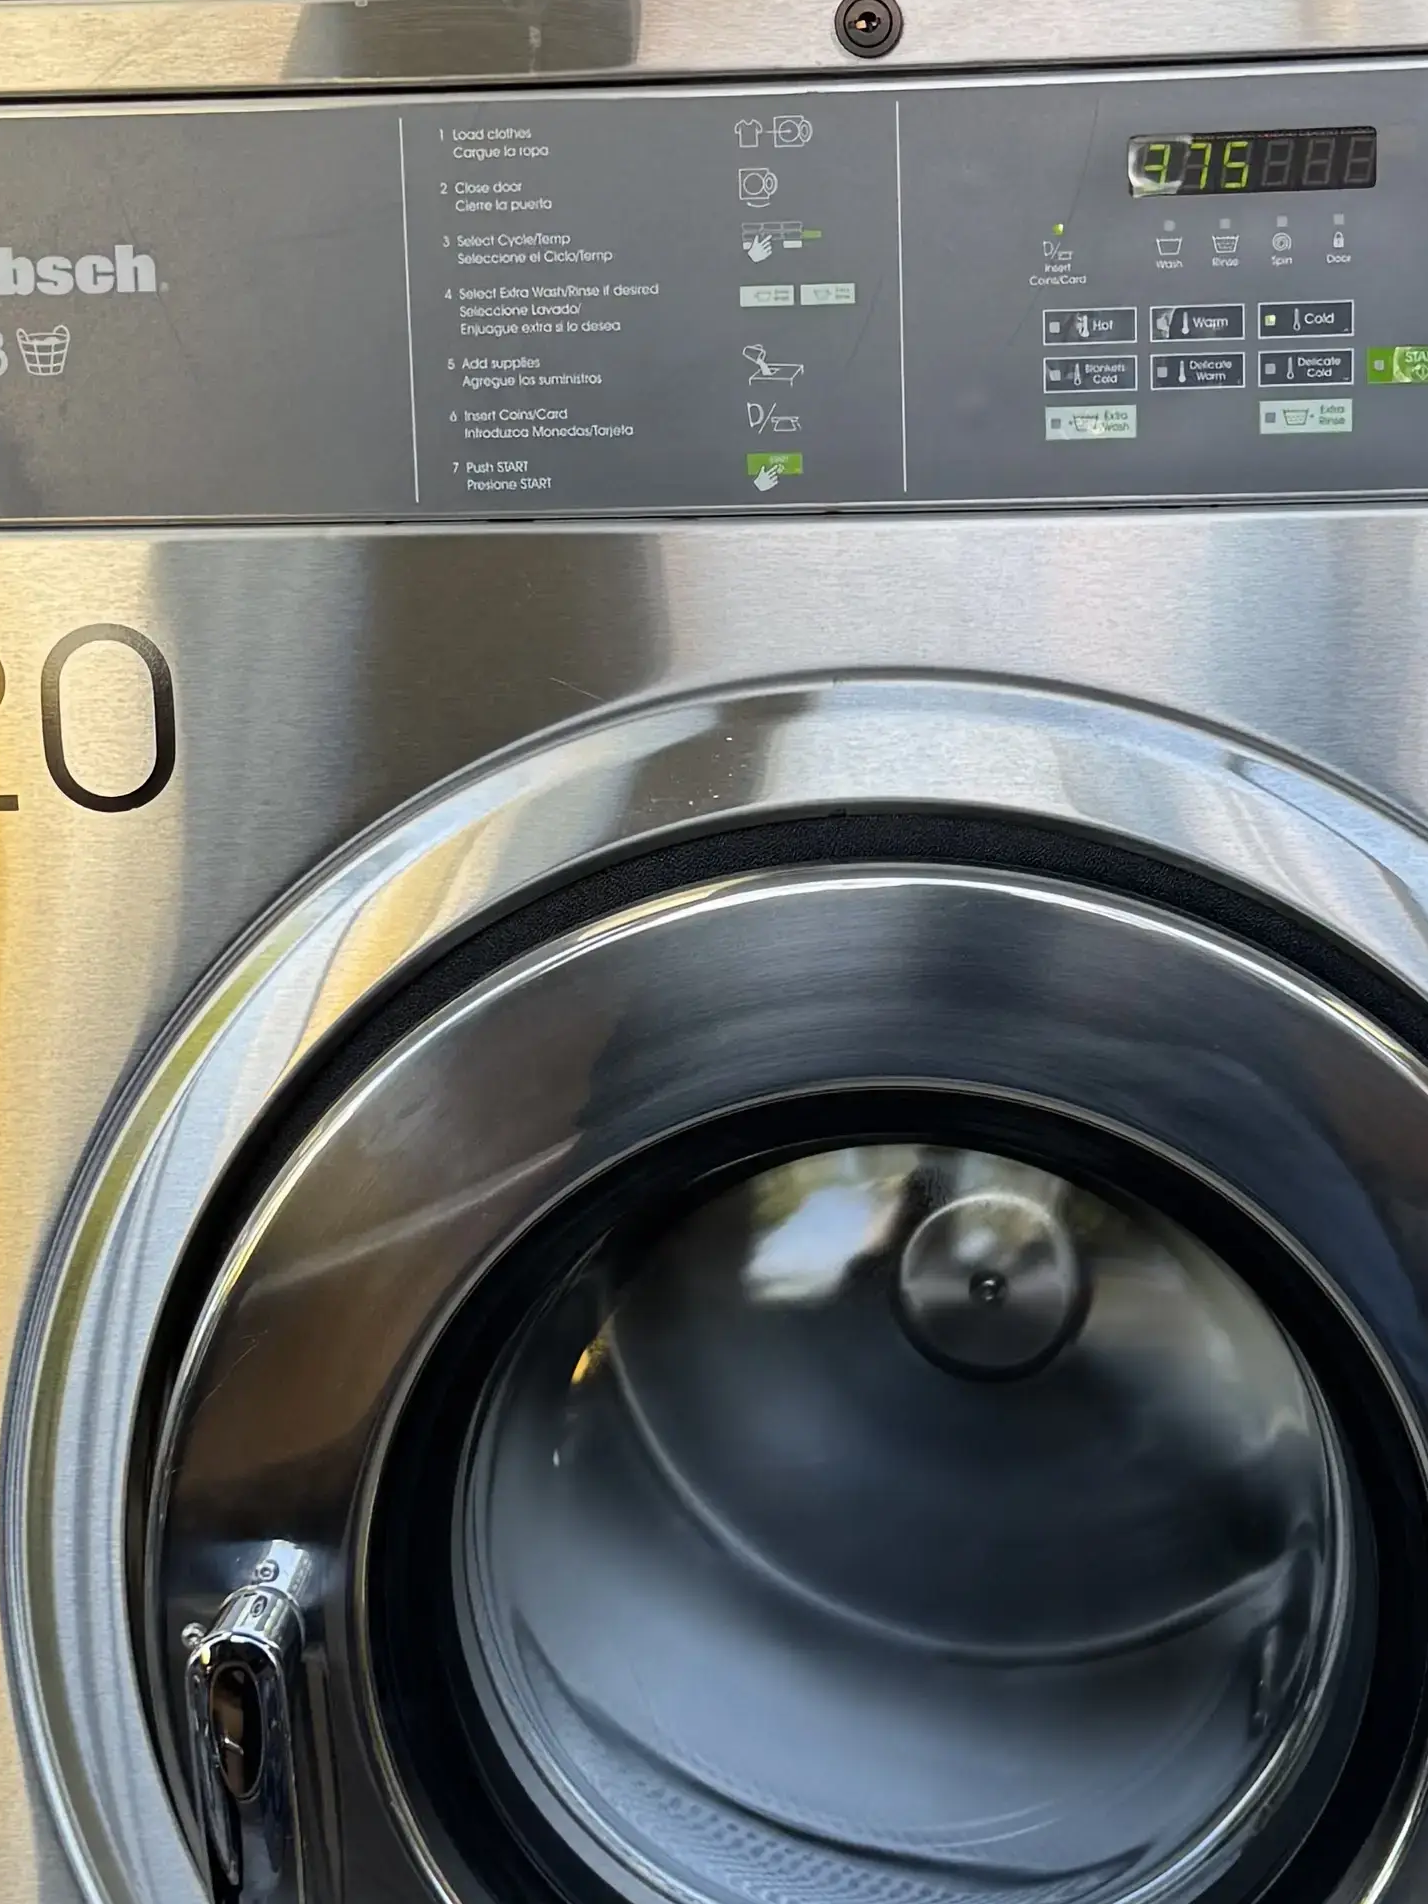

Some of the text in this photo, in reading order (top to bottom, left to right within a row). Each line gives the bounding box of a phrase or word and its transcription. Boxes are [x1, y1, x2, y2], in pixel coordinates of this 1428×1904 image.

[438, 127, 532, 141] 1 Load clothes
[453, 145, 549, 161] Cargue la ropa
[440, 181, 522, 195] 2 Close door
[455, 197, 553, 213] Cierre la puerta
[442, 232, 571, 248] 3 Select Cycle/Temp
[457, 249, 613, 265] Seleccione el Ciclo/Temp
[1326, 254, 1352, 264] Door
[1156, 260, 1184, 269] Wash
[444, 288, 453, 300] 4
[459, 287, 497, 300] Select
[500, 286, 529, 299] Extra
[531, 284, 600, 299] Wash/Rinse
[613, 282, 660, 296] desired
[459, 302, 583, 318] Seleccione Lavado/
[1193, 316, 1229, 330] Warm
[1304, 311, 1335, 325] Cold
[460, 319, 621, 338] Enjuague extra si lo desea
[1092, 319, 1114, 332] Hot
[447, 356, 541, 372] 5 Add supplies
[1189, 360, 1233, 371] Delicate
[1297, 356, 1341, 367] Delicate
[1092, 374, 1118, 385] Cold
[1196, 371, 1226, 382] Warm
[1306, 367, 1333, 378] Cold
[462, 372, 602, 390] Agregue los suministros
[449, 408, 568, 423] 6 Insert Coins/Card
[464, 426, 529, 440] Introduzca
[452, 460, 529, 475] 7 Push START
[466, 476, 552, 492] Presione START
